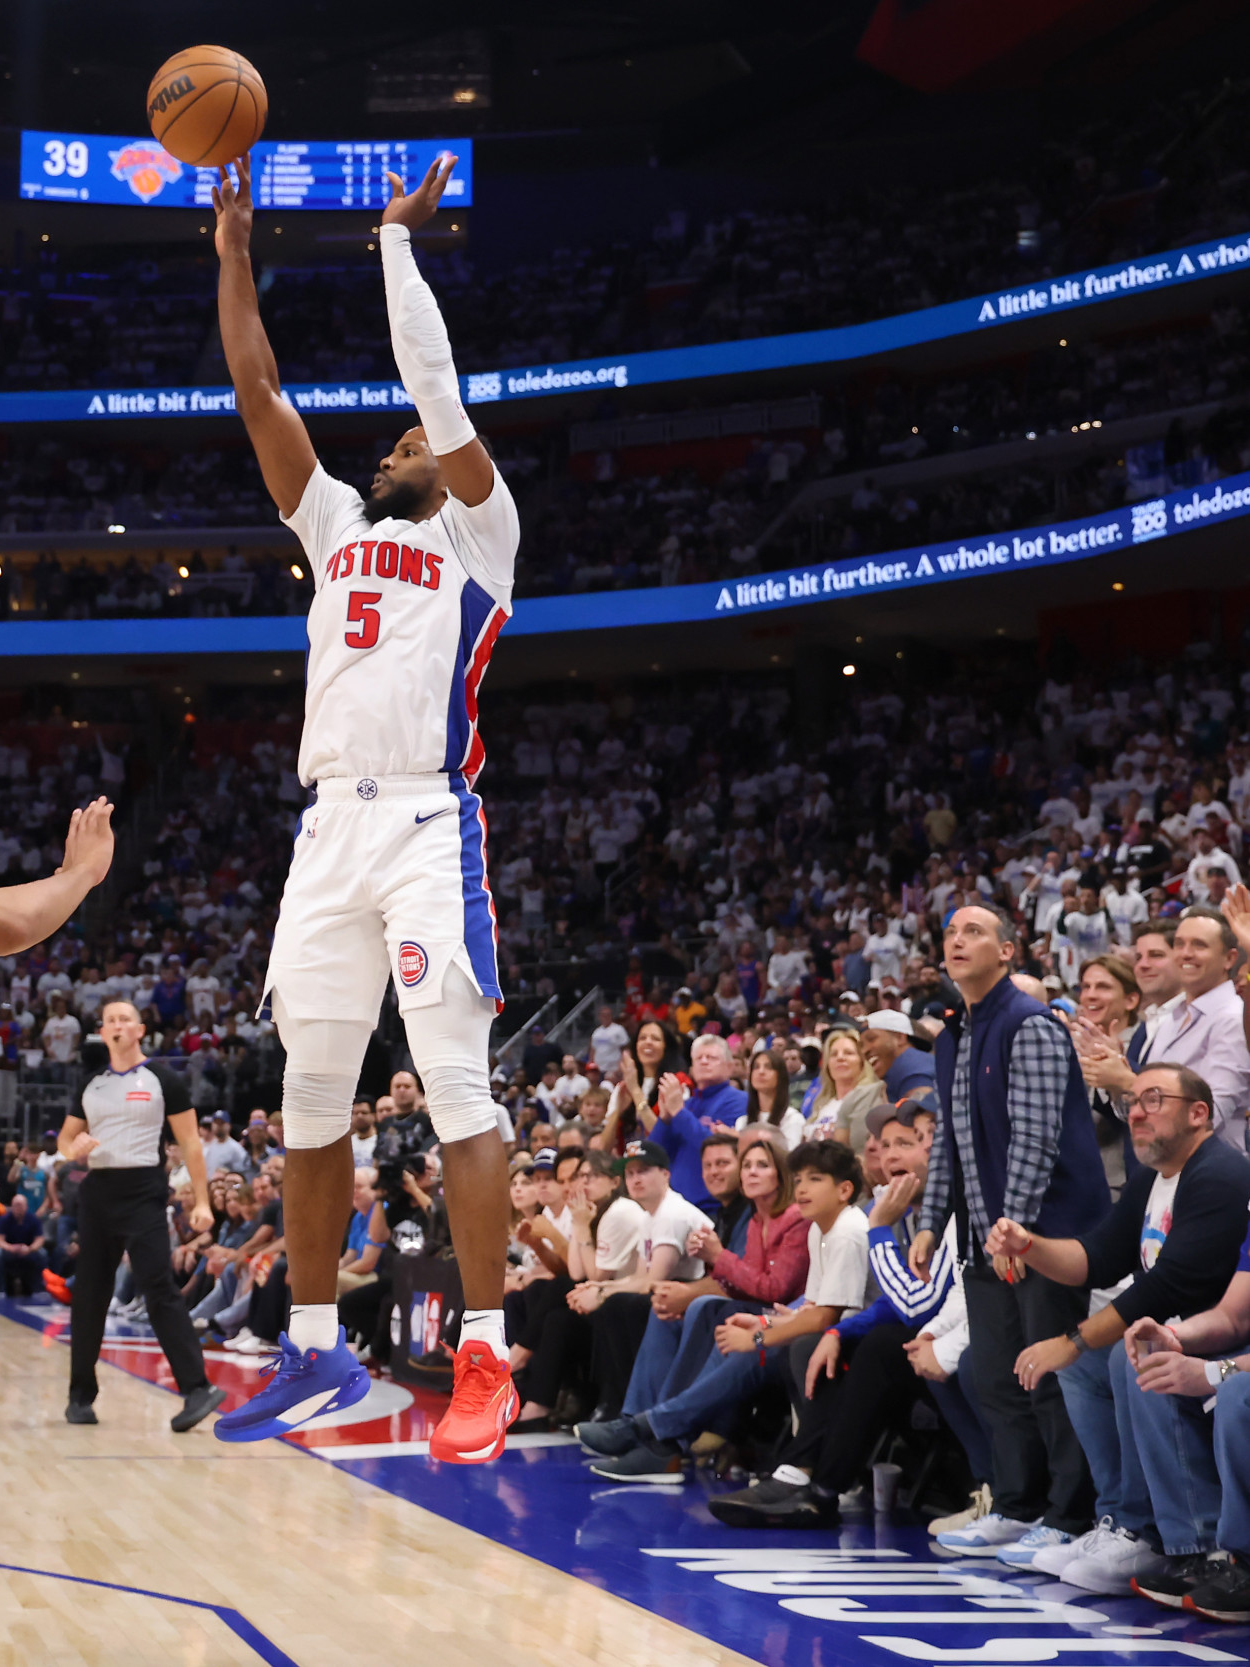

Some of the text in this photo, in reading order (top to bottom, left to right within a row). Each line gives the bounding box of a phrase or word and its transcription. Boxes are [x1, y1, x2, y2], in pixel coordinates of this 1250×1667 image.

[43, 140, 89, 178] 39
[978, 301, 997, 322] A
[998, 289, 1048, 317] little
[1050, 280, 1080, 304] bit
[1084, 263, 1172, 297] further.
[1176, 254, 1195, 276] A
[88, 395, 105, 414] A
[108, 393, 156, 413] little
[158, 392, 187, 412] bit
[295, 387, 358, 408] whole
[361, 387, 389, 406] lot
[507, 365, 628, 394] toledozoo.org
[326, 540, 444, 590] PISTONS
[715, 587, 734, 610] A
[736, 579, 786, 607] little
[788, 572, 819, 597] bit
[822, 561, 912, 593] further.
[914, 553, 935, 577] A
[937, 541, 1010, 573] whole
[1012, 536, 1045, 561] lot
[1048, 523, 1123, 554] better.
[344, 591, 383, 649] 5
